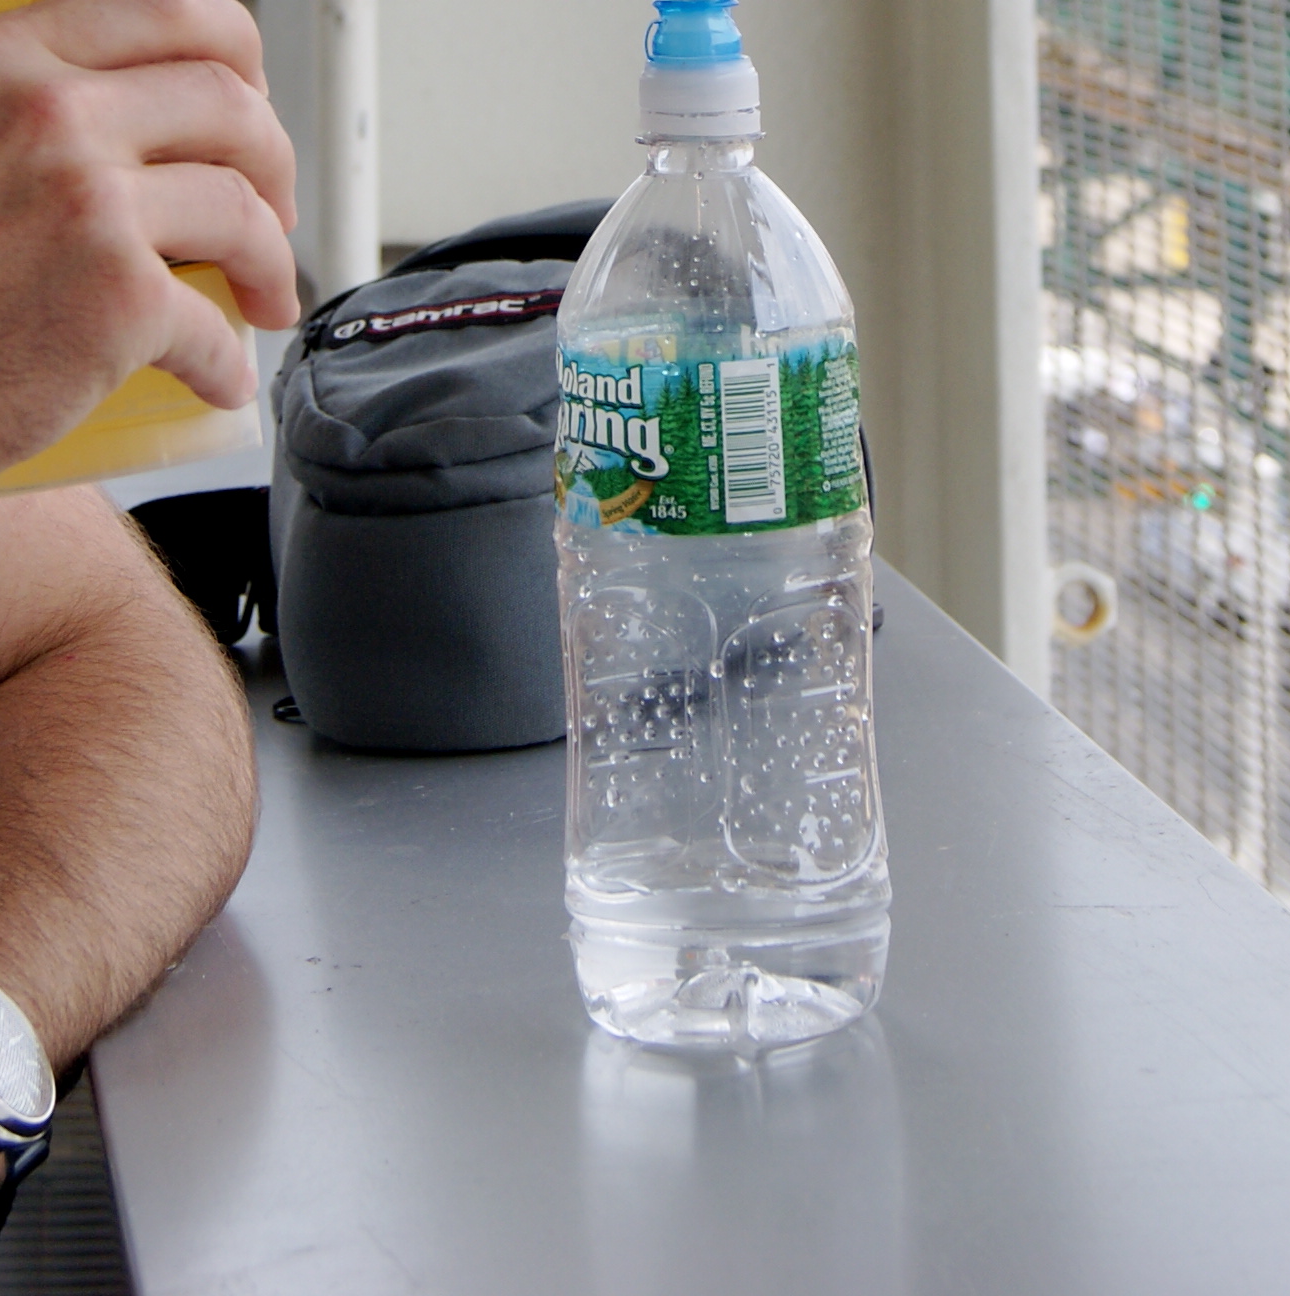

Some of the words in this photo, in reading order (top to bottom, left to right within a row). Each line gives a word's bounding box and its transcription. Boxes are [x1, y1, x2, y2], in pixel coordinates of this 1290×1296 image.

[370, 299, 525, 331] tamrac
[765, 390, 779, 434] 43115
[767, 442, 781, 487] 75720
[658, 495, 677, 505] Est.
[773, 507, 782, 516] 0
[649, 505, 687, 519] 1845
